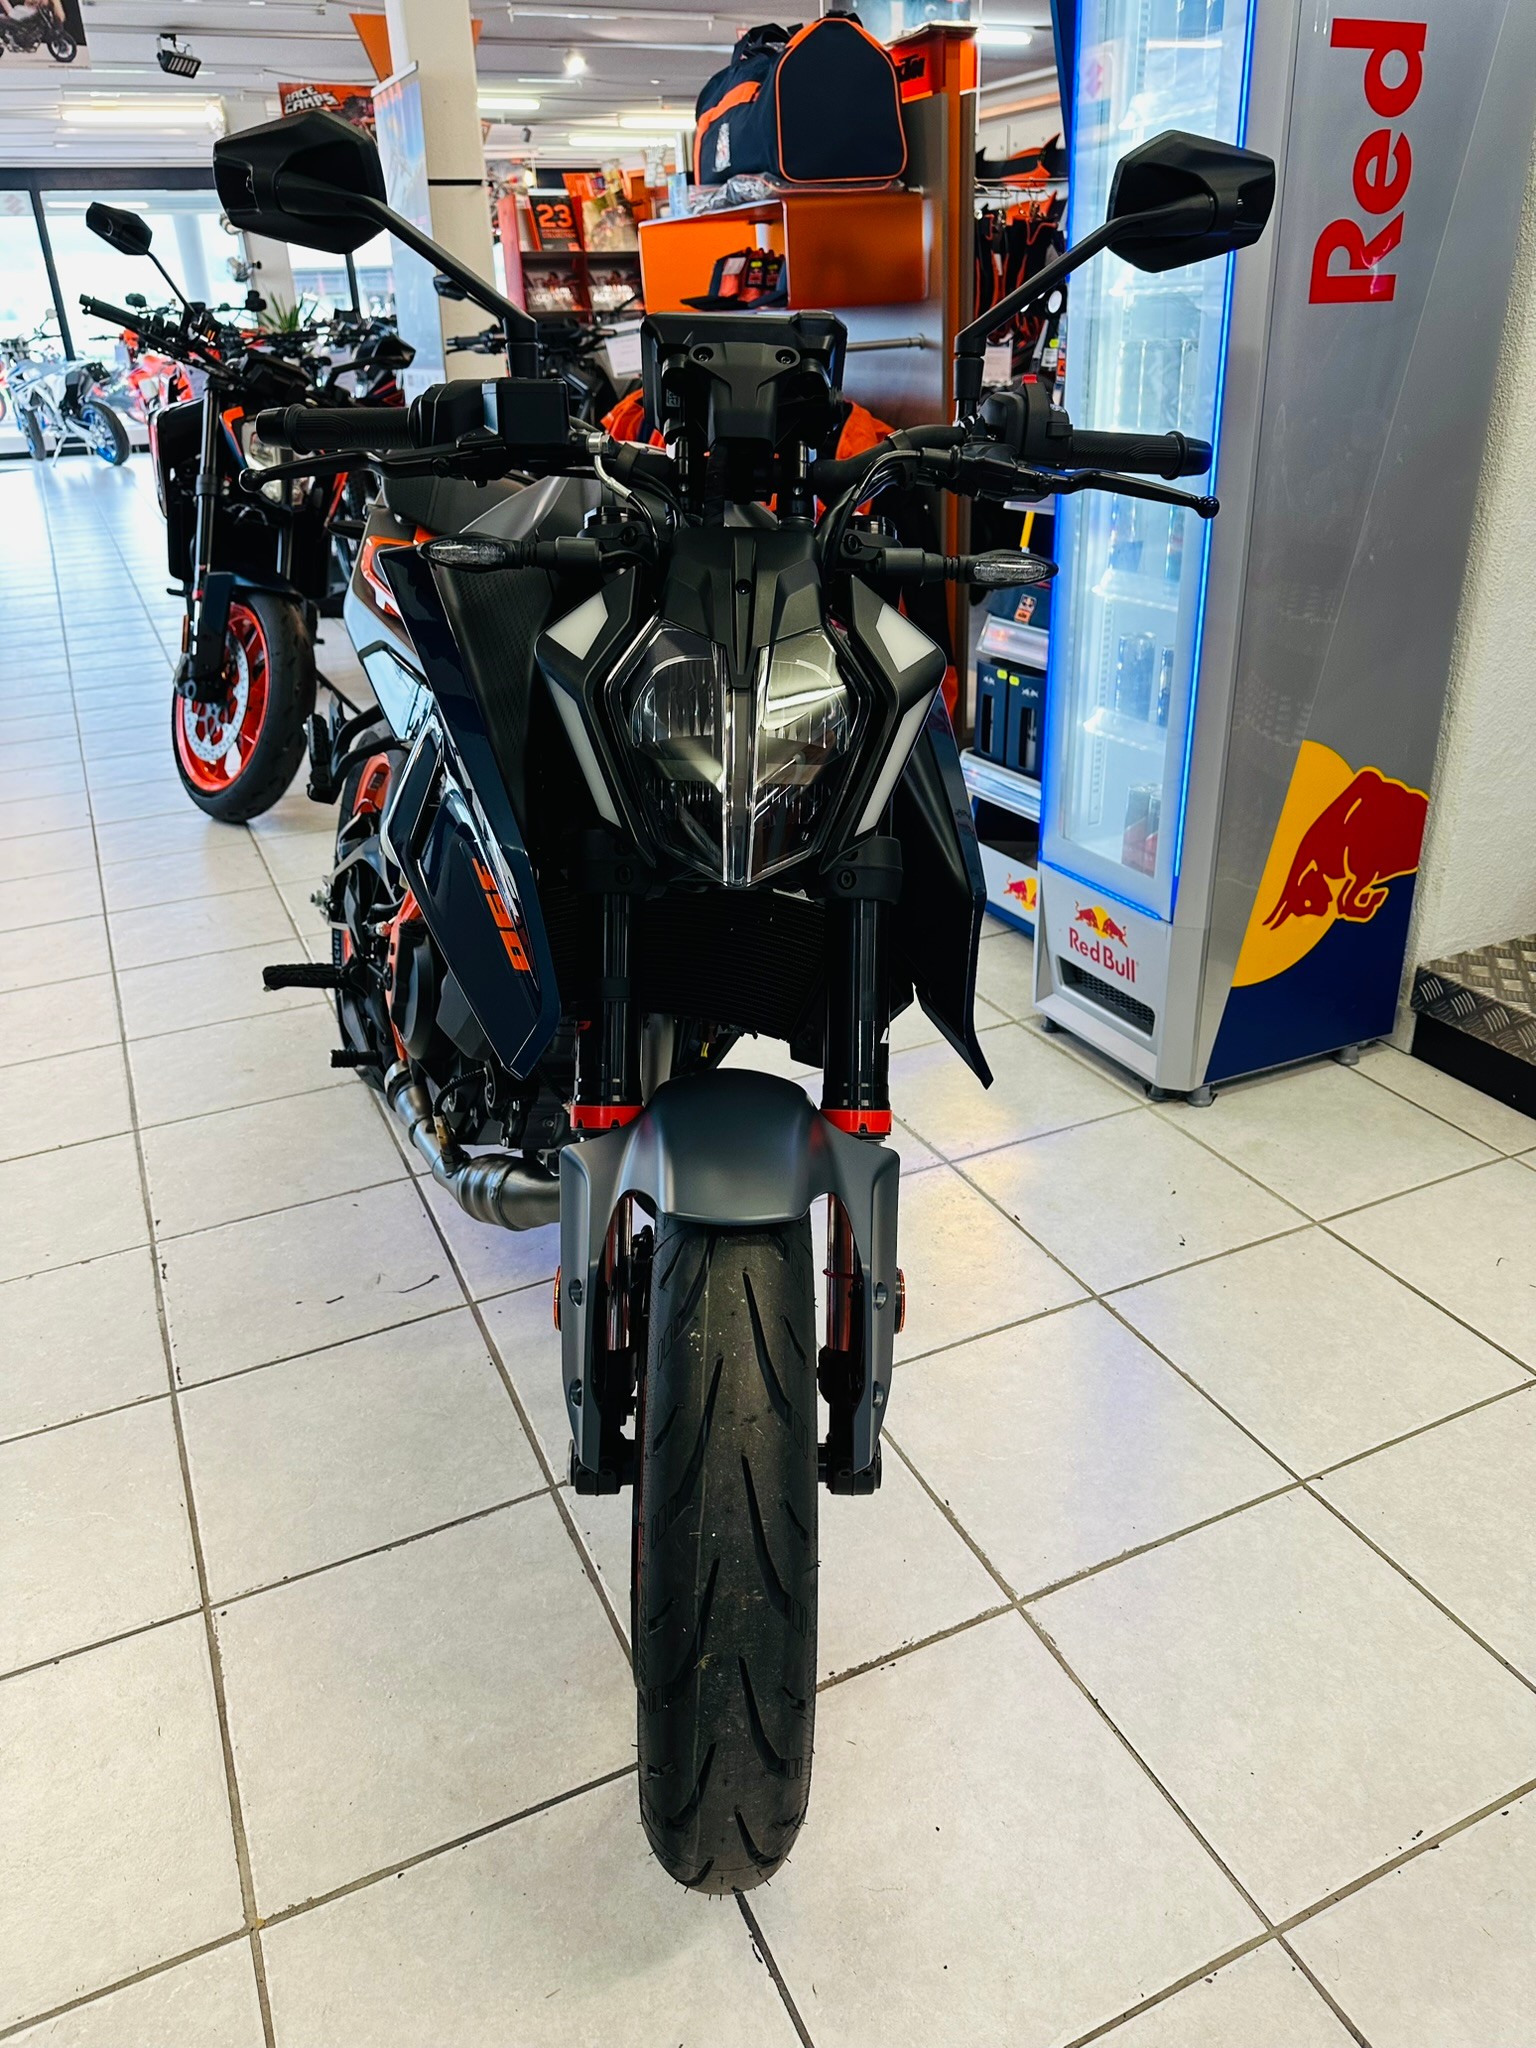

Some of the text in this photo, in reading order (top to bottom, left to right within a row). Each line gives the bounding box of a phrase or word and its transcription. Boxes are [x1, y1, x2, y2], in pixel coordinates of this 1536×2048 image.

[285, 92, 340, 115] CAMPS
[1308, 17, 1428, 305] Red
[536, 203, 573, 228] 23
[471, 857, 531, 971] 390
[1069, 926, 1136, 984] Red Bull
